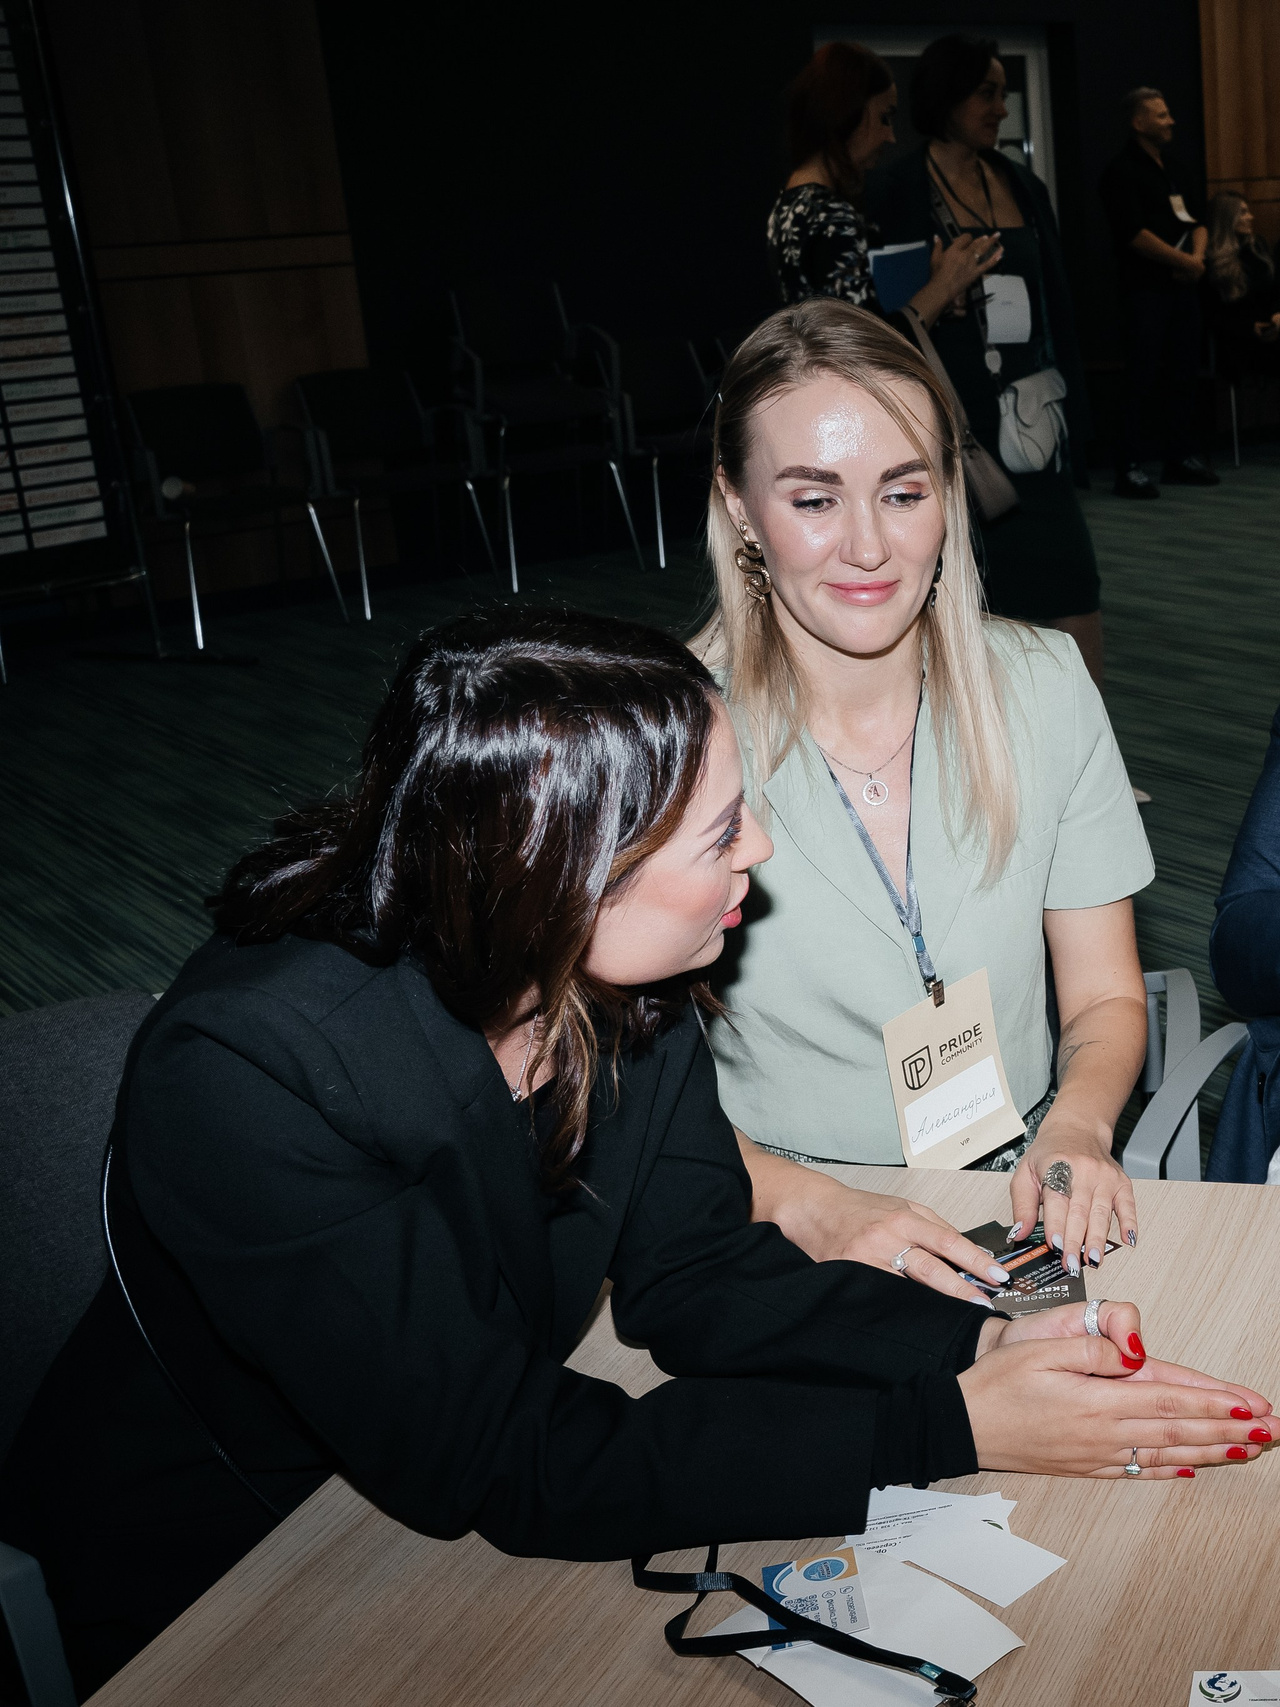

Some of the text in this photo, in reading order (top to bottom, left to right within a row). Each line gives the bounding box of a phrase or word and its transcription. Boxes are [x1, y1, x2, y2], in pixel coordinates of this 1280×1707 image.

[939, 1023, 982, 1057] PRIDE
[941, 1037, 984, 1065] COMMUNITY
[960, 1137, 970, 1146] VIP
[998, 1285, 1069, 1298] Екатина
[1015, 1292, 1070, 1303] Козеева
